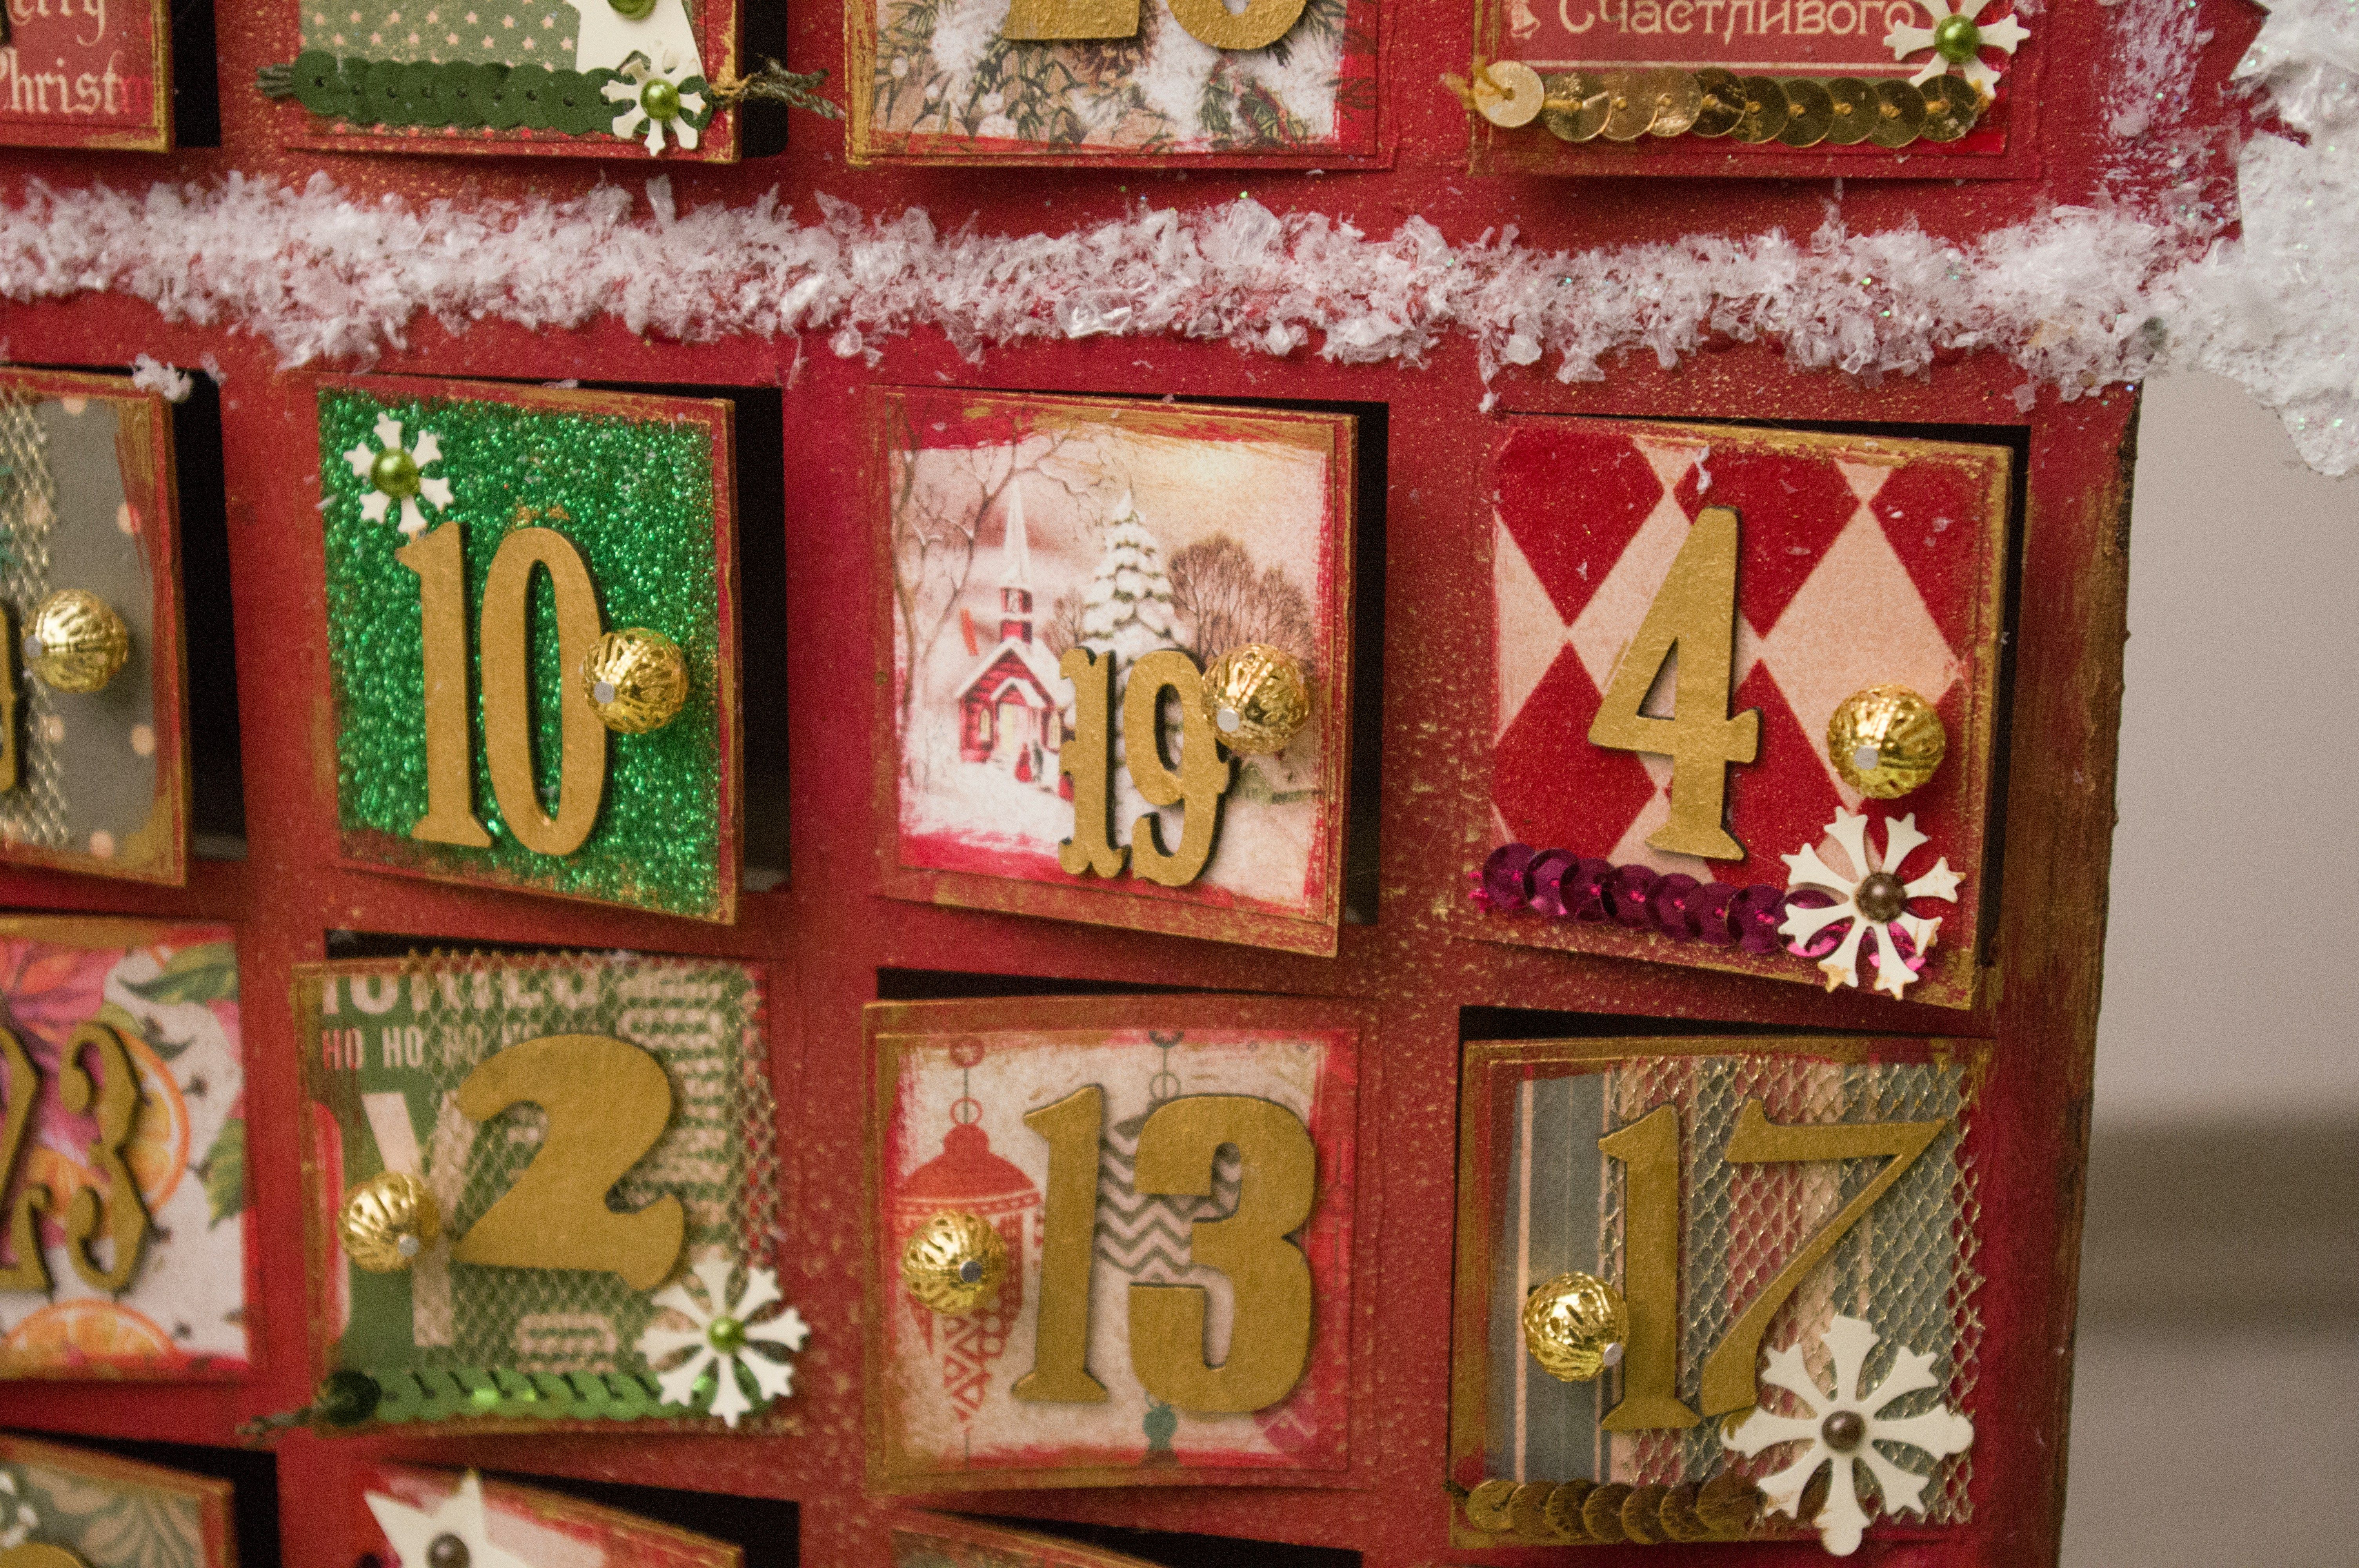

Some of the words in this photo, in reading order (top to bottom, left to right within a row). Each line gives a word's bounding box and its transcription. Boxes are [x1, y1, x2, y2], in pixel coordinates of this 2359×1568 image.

[395, 521, 607, 855] 10
[1059, 646, 1227, 887] 19
[1587, 504, 1761, 861] 4
[324, 1028, 363, 1070] HO
[382, 1025, 424, 1069] HO
[454, 1033, 685, 1290] 2
[1010, 1083, 1316, 1412] 13
[1597, 1098, 1947, 1430] 17
